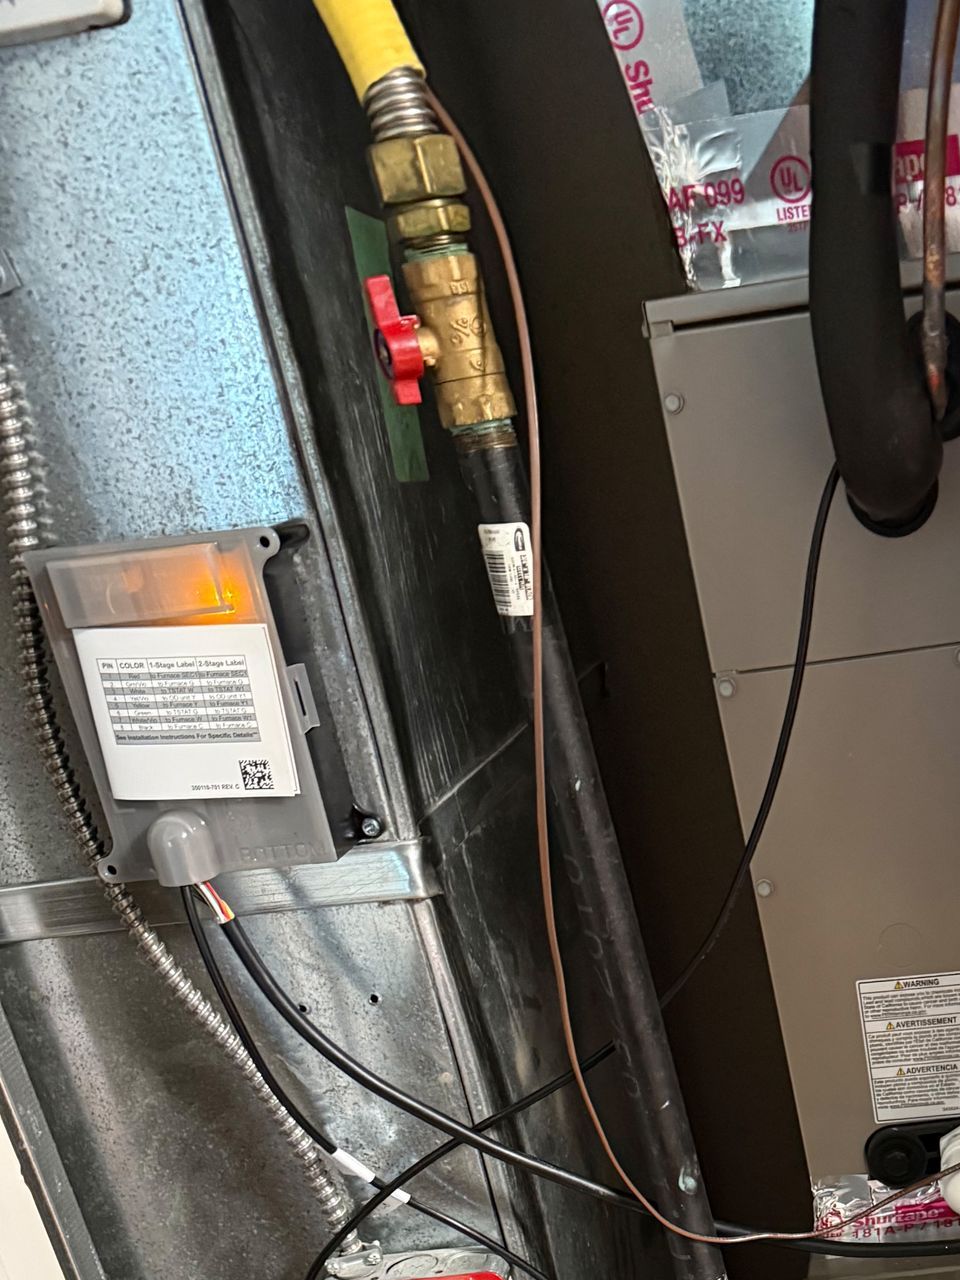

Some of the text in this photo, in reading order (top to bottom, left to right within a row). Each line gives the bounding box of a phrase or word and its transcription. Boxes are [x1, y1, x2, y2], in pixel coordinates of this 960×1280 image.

[668, 178, 745, 211] AF 099
[903, 978, 940, 989] WARNING
